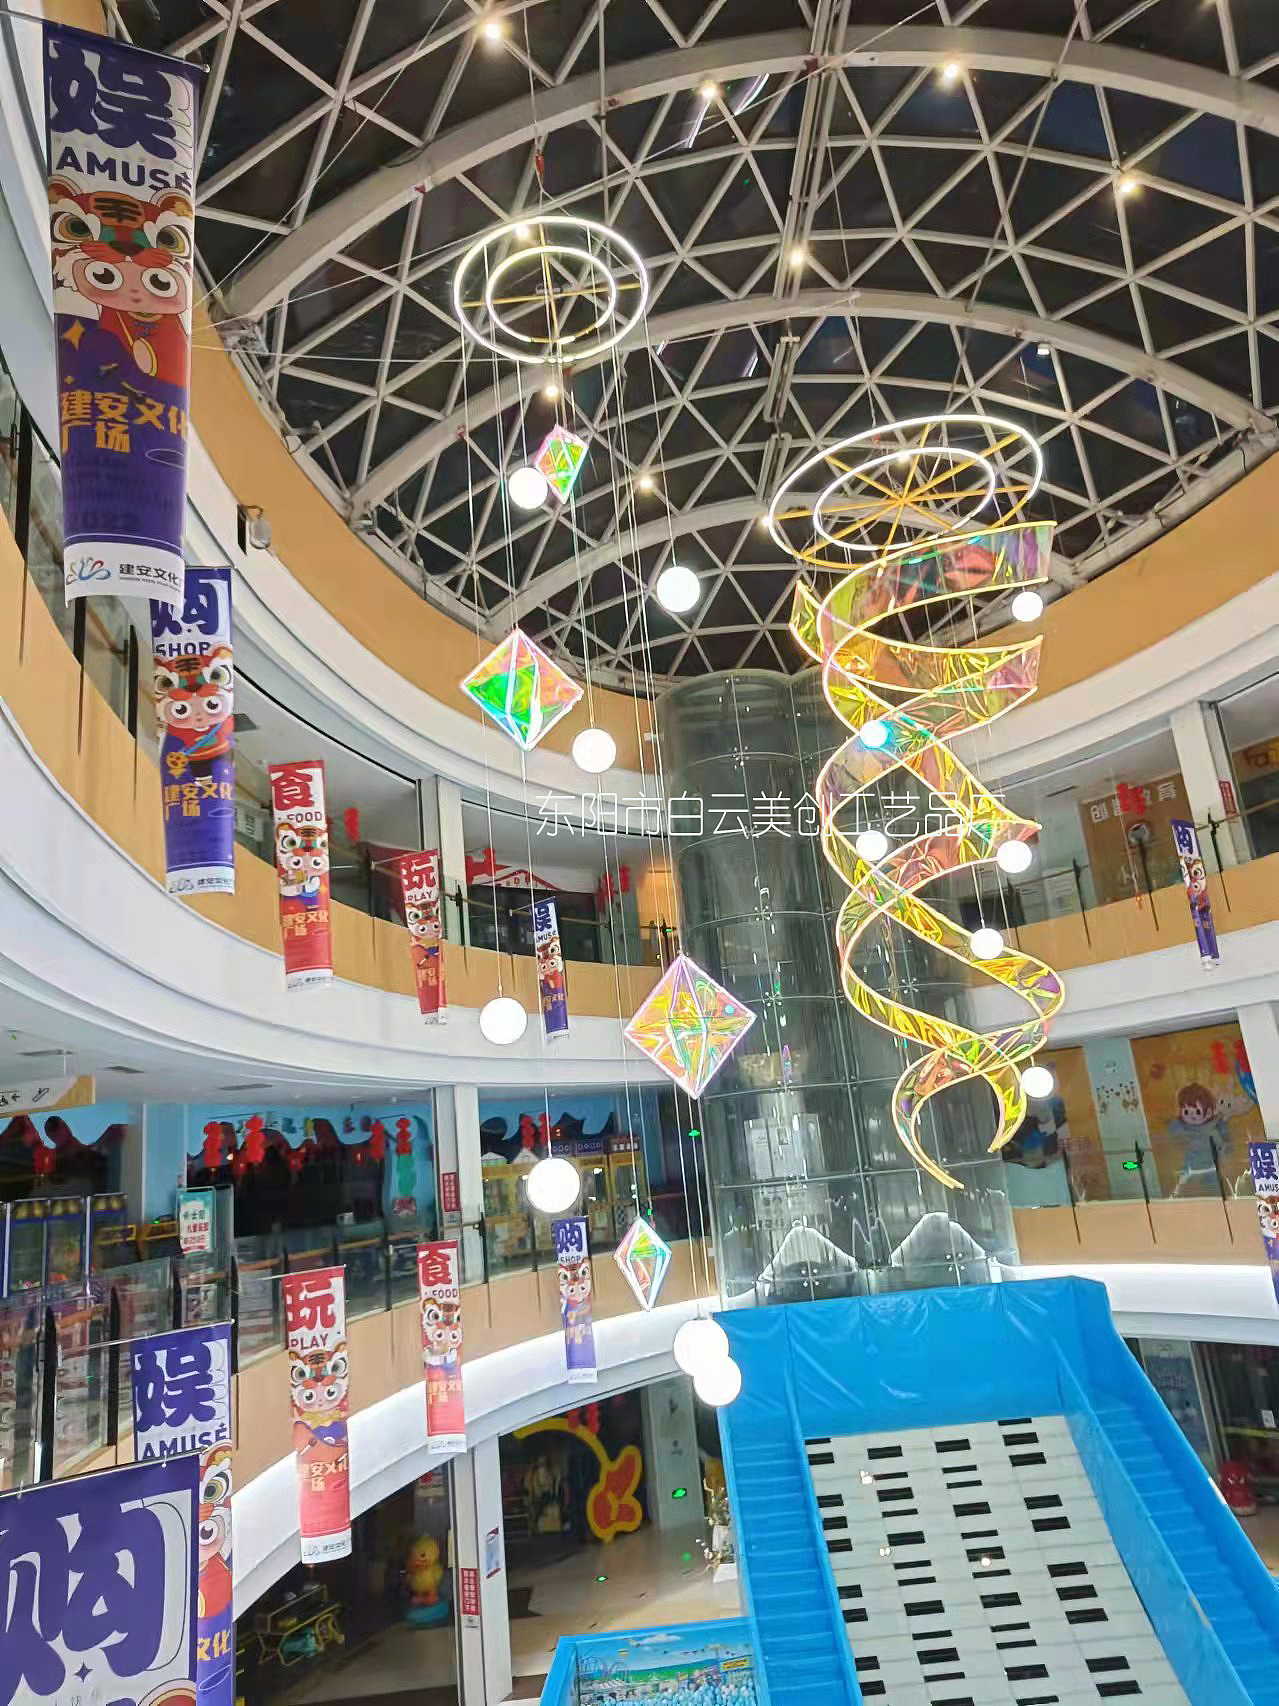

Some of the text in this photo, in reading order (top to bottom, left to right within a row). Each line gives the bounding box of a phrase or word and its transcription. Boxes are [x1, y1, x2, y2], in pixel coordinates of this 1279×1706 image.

[48, 36, 178, 161] 娱
[56, 146, 192, 196] AMUSE
[61, 421, 131, 454] 广场
[155, 642, 211, 658] SHOP
[407, 890, 432, 902] PLAY
[289, 1333, 329, 1350] PLAY
[130, 1343, 216, 1433] 娱
